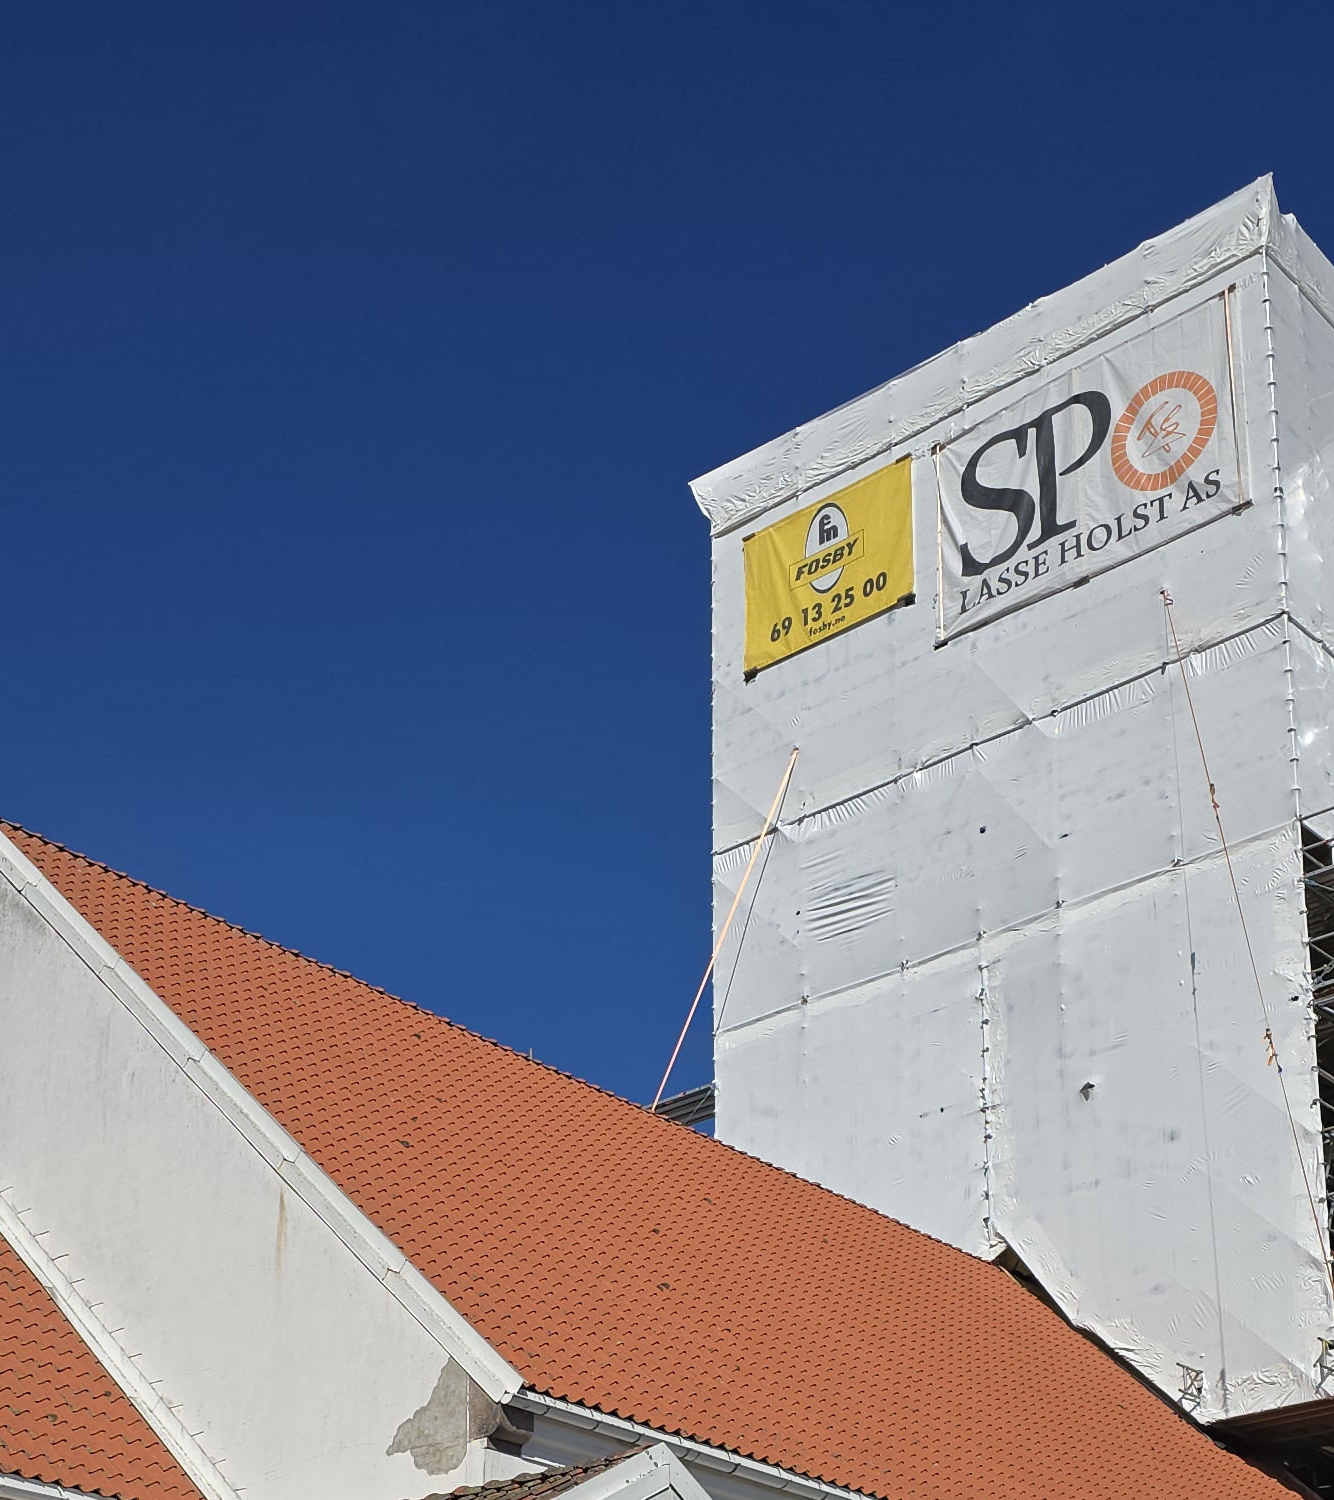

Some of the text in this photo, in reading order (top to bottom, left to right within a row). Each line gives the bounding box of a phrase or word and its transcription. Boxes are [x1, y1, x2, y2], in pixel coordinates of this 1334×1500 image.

[794, 536, 860, 582] FOSBY
[958, 468, 1222, 615] LASSE HOLST AS
[770, 571, 888, 643] 69 13 25 00
[808, 614, 846, 637] fosby.no
